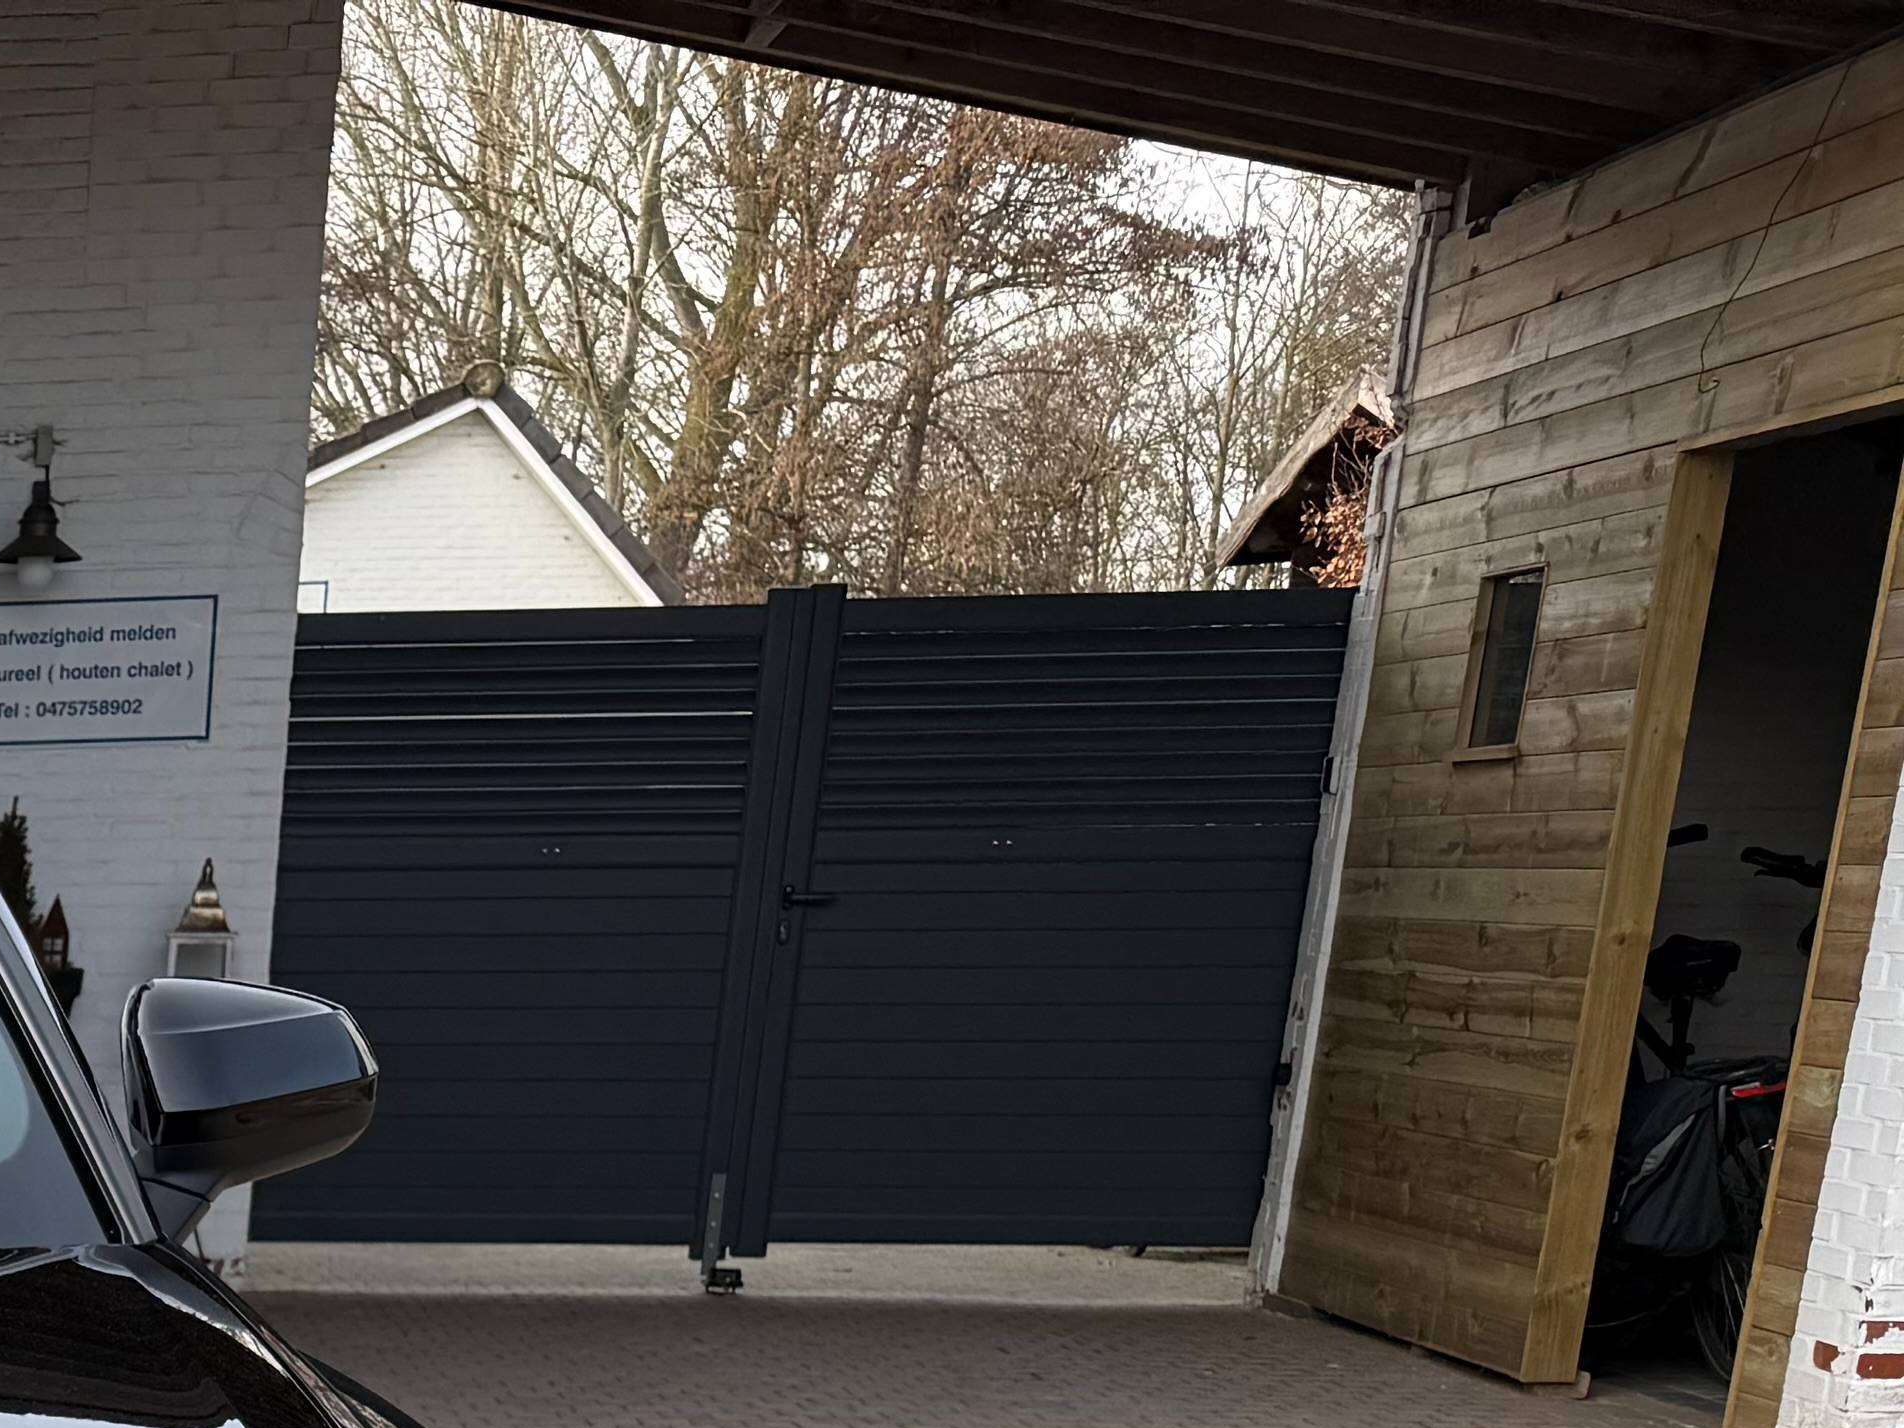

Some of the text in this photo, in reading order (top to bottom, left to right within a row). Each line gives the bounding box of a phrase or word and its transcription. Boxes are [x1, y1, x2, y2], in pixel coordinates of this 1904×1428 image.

[110, 625, 177, 641] melden
[59, 663, 121, 680] houten
[127, 661, 182, 678] chalet
[36, 699, 143, 717] 0475758902
